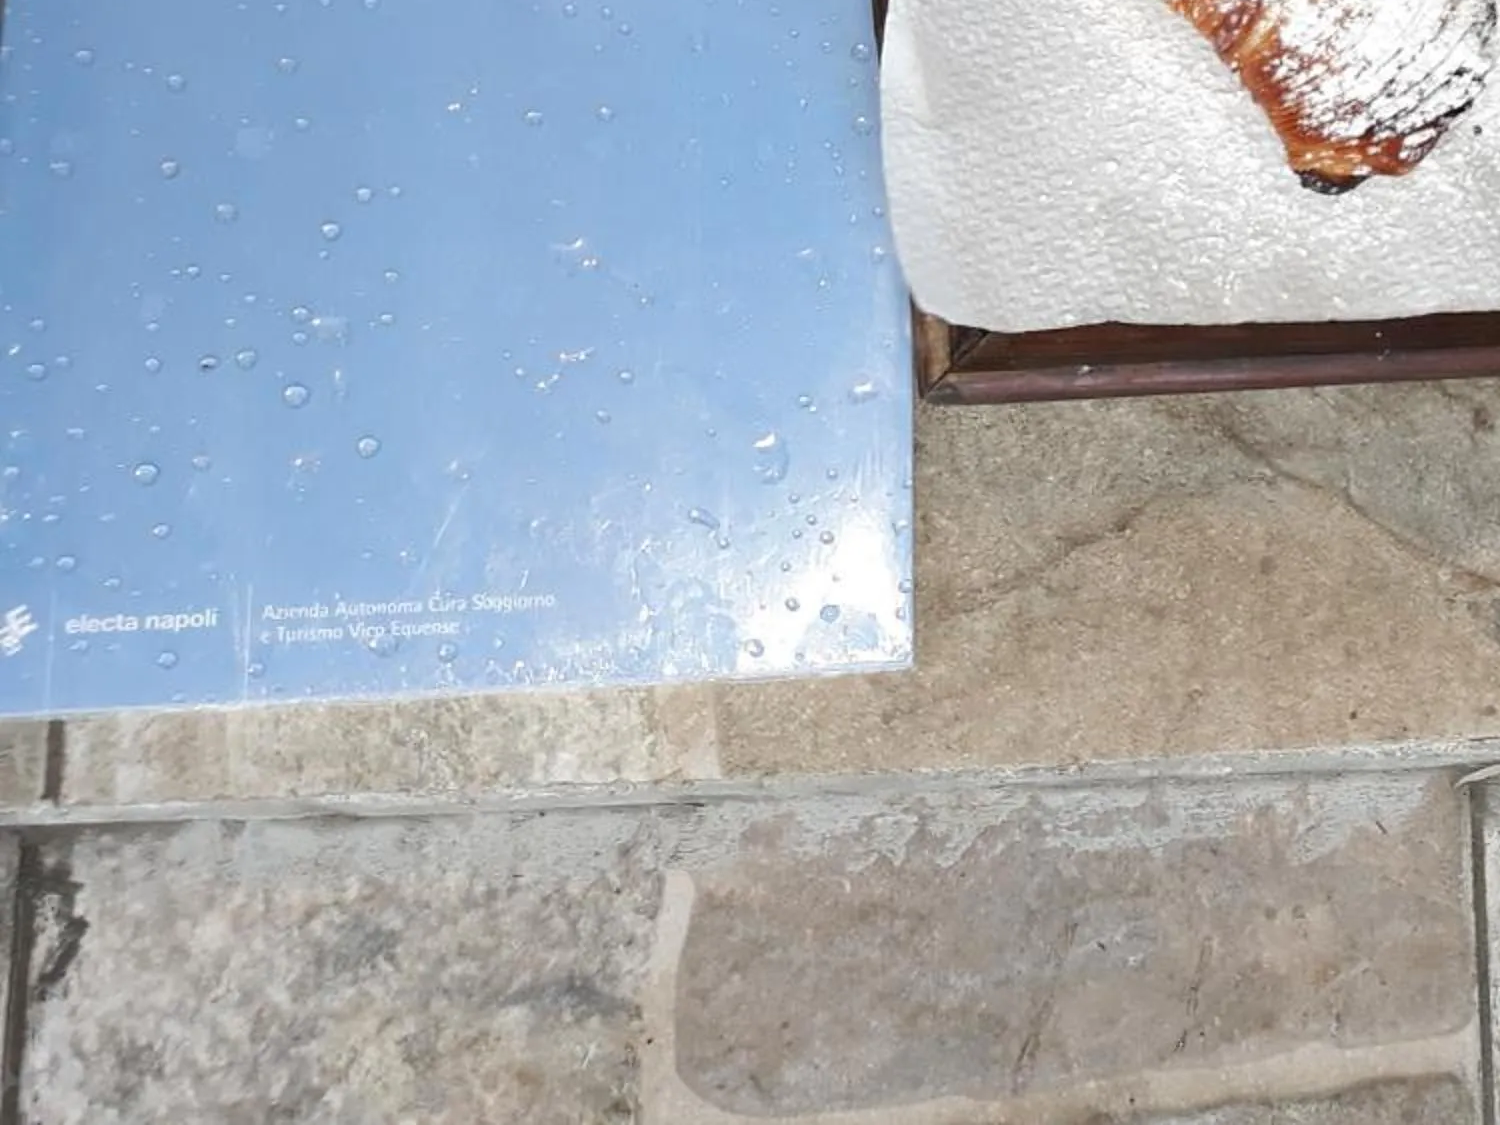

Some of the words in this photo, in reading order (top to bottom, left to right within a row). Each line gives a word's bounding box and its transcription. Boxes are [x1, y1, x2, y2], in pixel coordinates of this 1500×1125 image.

[262, 602, 329, 621] Azienda
[335, 599, 423, 619] Autonoma
[428, 595, 466, 614] Cura
[472, 592, 557, 614] Soggiorno
[66, 613, 139, 634] electa
[144, 608, 219, 632] napoli
[276, 626, 343, 644] Turismo
[348, 622, 385, 639] Vico
[391, 620, 461, 639] Equense
